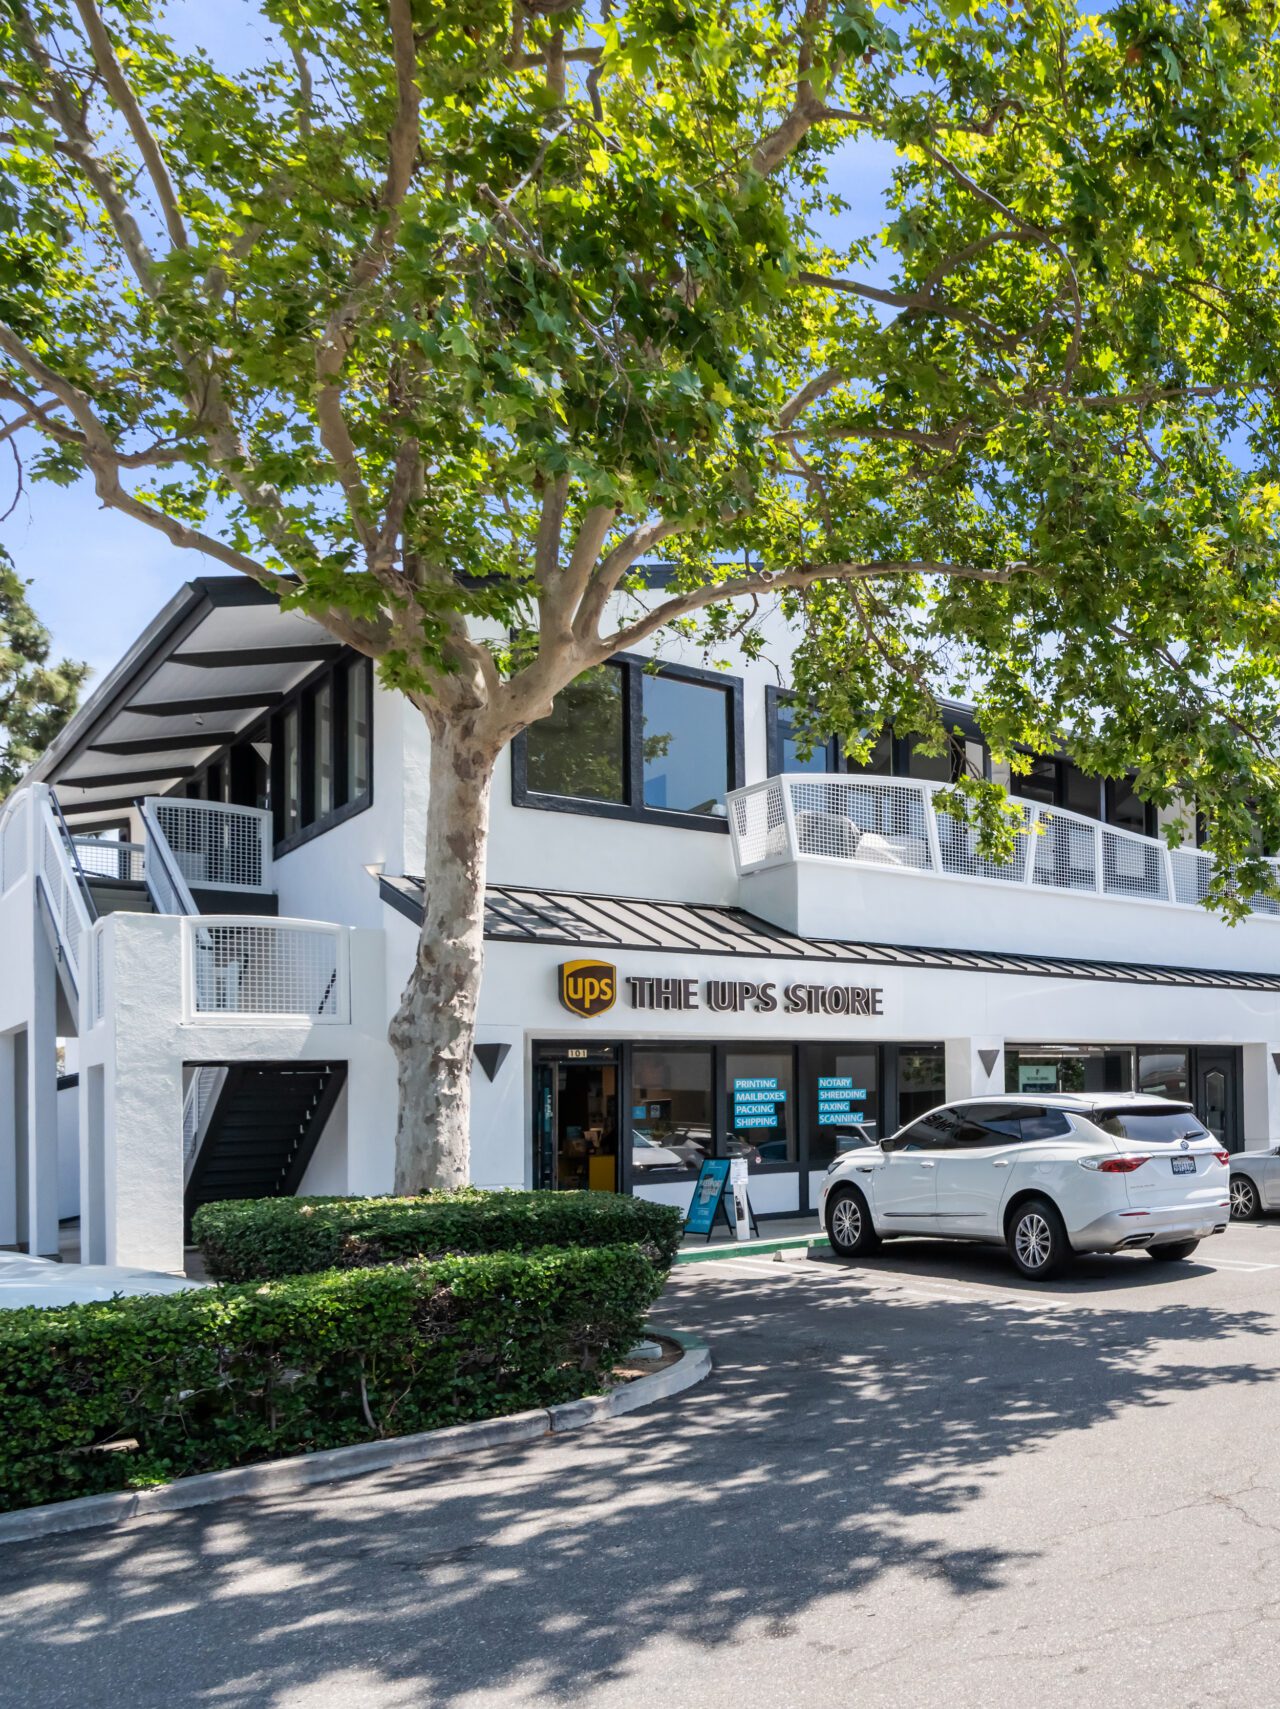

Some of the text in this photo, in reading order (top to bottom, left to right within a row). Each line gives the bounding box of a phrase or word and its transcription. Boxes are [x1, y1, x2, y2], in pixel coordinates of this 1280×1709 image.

[568, 977, 612, 1008] ups
[627, 976, 884, 1016] THE UPS STORE
[735, 1079, 777, 1089] PRINTING
[819, 1078, 851, 1088] NOTARY
[736, 1091, 785, 1101] MAILBOXES
[820, 1090, 865, 1099] SHREDDING
[736, 1103, 774, 1114] PACKING
[820, 1101, 849, 1111] FAXING
[736, 1116, 777, 1127] SHIPPING
[819, 1113, 863, 1124] SCANNING
